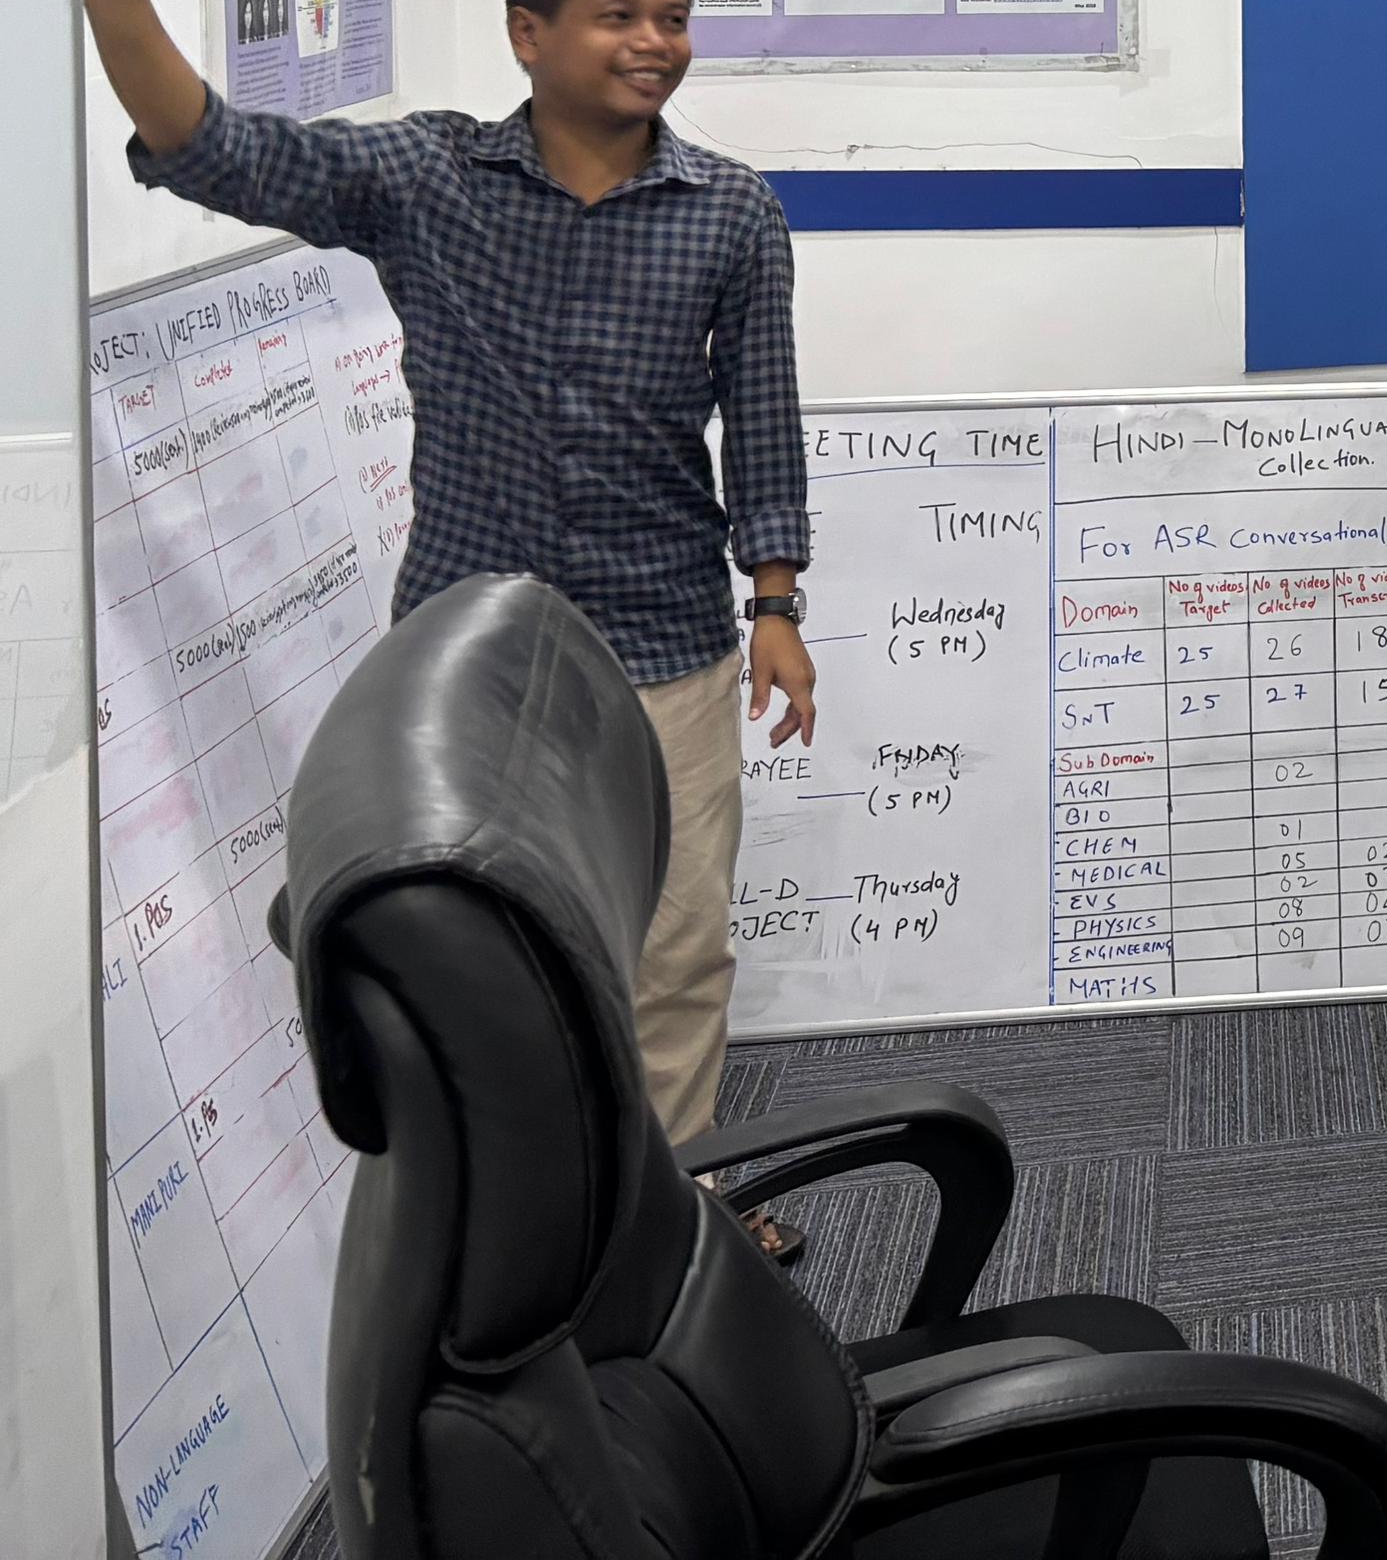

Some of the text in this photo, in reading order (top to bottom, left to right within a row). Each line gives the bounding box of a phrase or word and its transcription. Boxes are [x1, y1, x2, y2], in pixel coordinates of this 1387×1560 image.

[156, 302, 221, 361] UNIFIED
[227, 283, 289, 334] PROGRESS
[293, 265, 331, 302] BOARD
[803, 429, 1044, 466] ETING TIME
[919, 503, 1042, 543] TIMING
[1081, 526, 1131, 564] For
[1155, 524, 1216, 554] ASR
[1230, 517, 1386, 550] Conversational
[1168, 581, 1191, 594] No
[1207, 578, 1245, 594] videos
[1253, 579, 1272, 592] No
[1294, 576, 1331, 589] videos
[1336, 572, 1354, 587] No
[892, 598, 1005, 630] Wednesday
[1063, 597, 1138, 628] Domain
[1180, 600, 1231, 622] Target
[1257, 598, 1317, 615] Collected
[1058, 646, 1146, 673] Climate
[1179, 646, 1213, 664] 25
[1266, 634, 1302, 660] 26
[1357, 625, 1387, 653] 18
[1180, 695, 1221, 715] 25
[1267, 686, 1307, 703] 27
[1275, 763, 1313, 781] 02
[1063, 780, 1109, 798] AGRI
[1066, 809, 1110, 825] BIO
[1066, 818, 1302, 856] CHEM 01
[1072, 861, 1167, 886] MEDICAL
[1282, 852, 1305, 869] 05
[854, 871, 959, 906] Thursday
[1070, 895, 1117, 911] EVS
[1281, 876, 1318, 892] 02
[1075, 916, 1156, 937] PHYSICS
[1279, 898, 1303, 919] 08
[1069, 940, 1173, 962] ENGINEERING
[1279, 926, 1304, 949] 09
[1070, 976, 1157, 997] MATHS
[171, 1484, 219, 1560] STAFF
